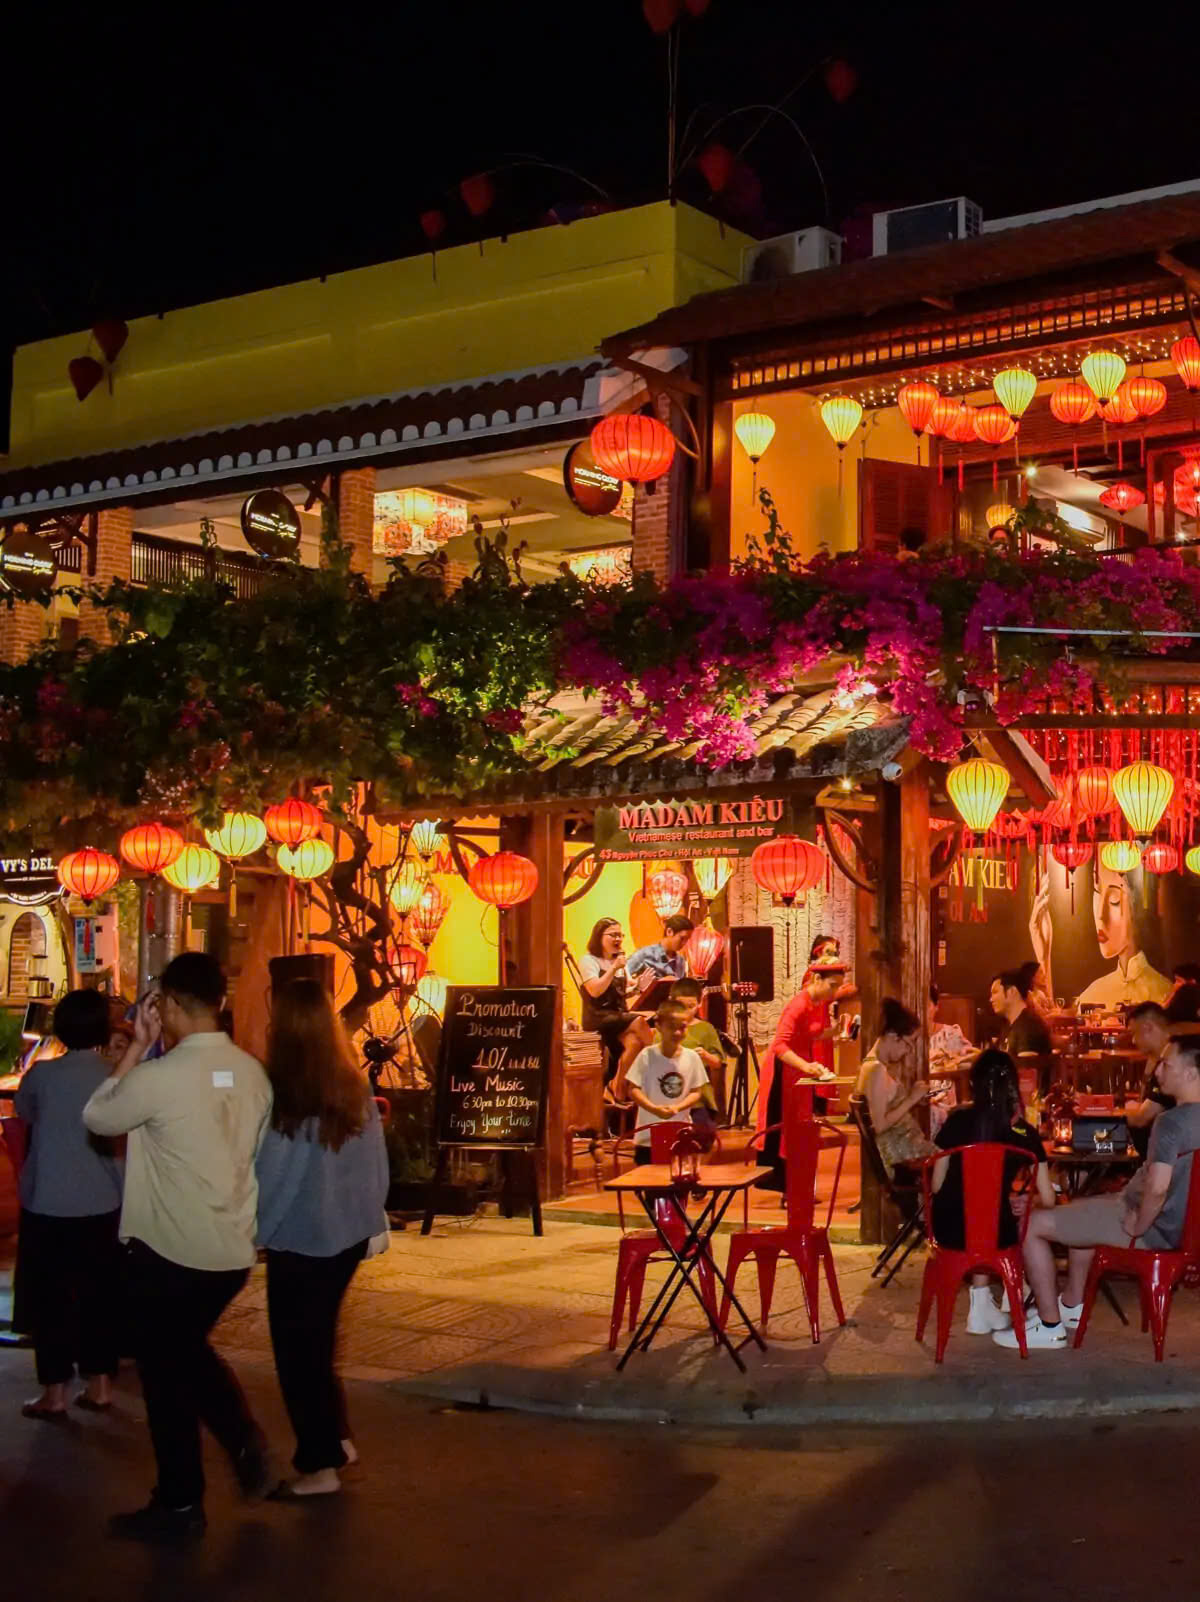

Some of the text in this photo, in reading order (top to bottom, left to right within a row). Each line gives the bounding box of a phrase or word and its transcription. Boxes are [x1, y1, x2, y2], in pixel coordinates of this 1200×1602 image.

[618, 802, 713, 829] MADAM
[628, 826, 775, 843] Vietnamese restaurant and bar
[2, 857, 58, 872] VY'S DEL
[456, 993, 538, 1018] Promotion
[465, 1021, 525, 1039] Discount
[472, 1046, 509, 1071] 10%
[451, 1073, 525, 1092] Live Music
[496, 1095, 505, 1107] to
[450, 1113, 476, 1135] Enjoy
[506, 1110, 531, 1127] time
